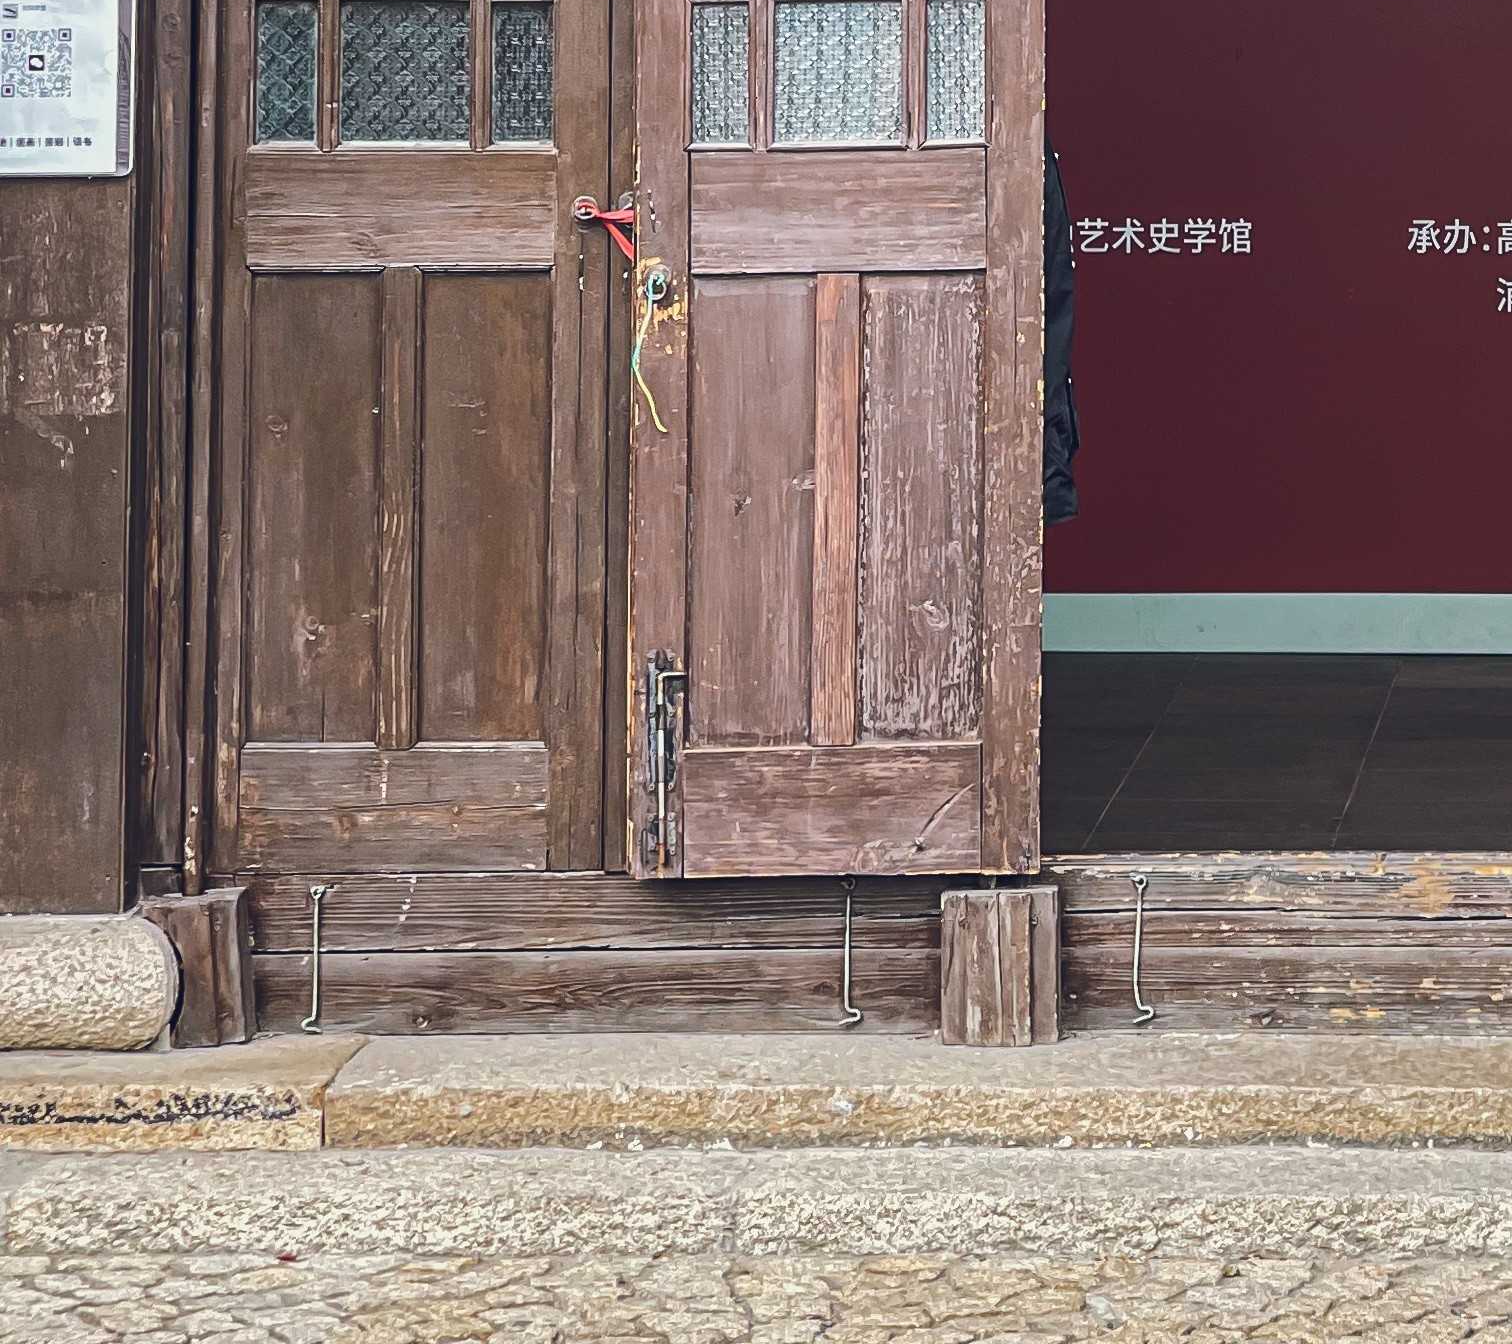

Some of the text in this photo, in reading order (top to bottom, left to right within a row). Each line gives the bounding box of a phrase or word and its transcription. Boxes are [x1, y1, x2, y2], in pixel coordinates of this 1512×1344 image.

[1069, 217, 1252, 254] 艺术史学馆
